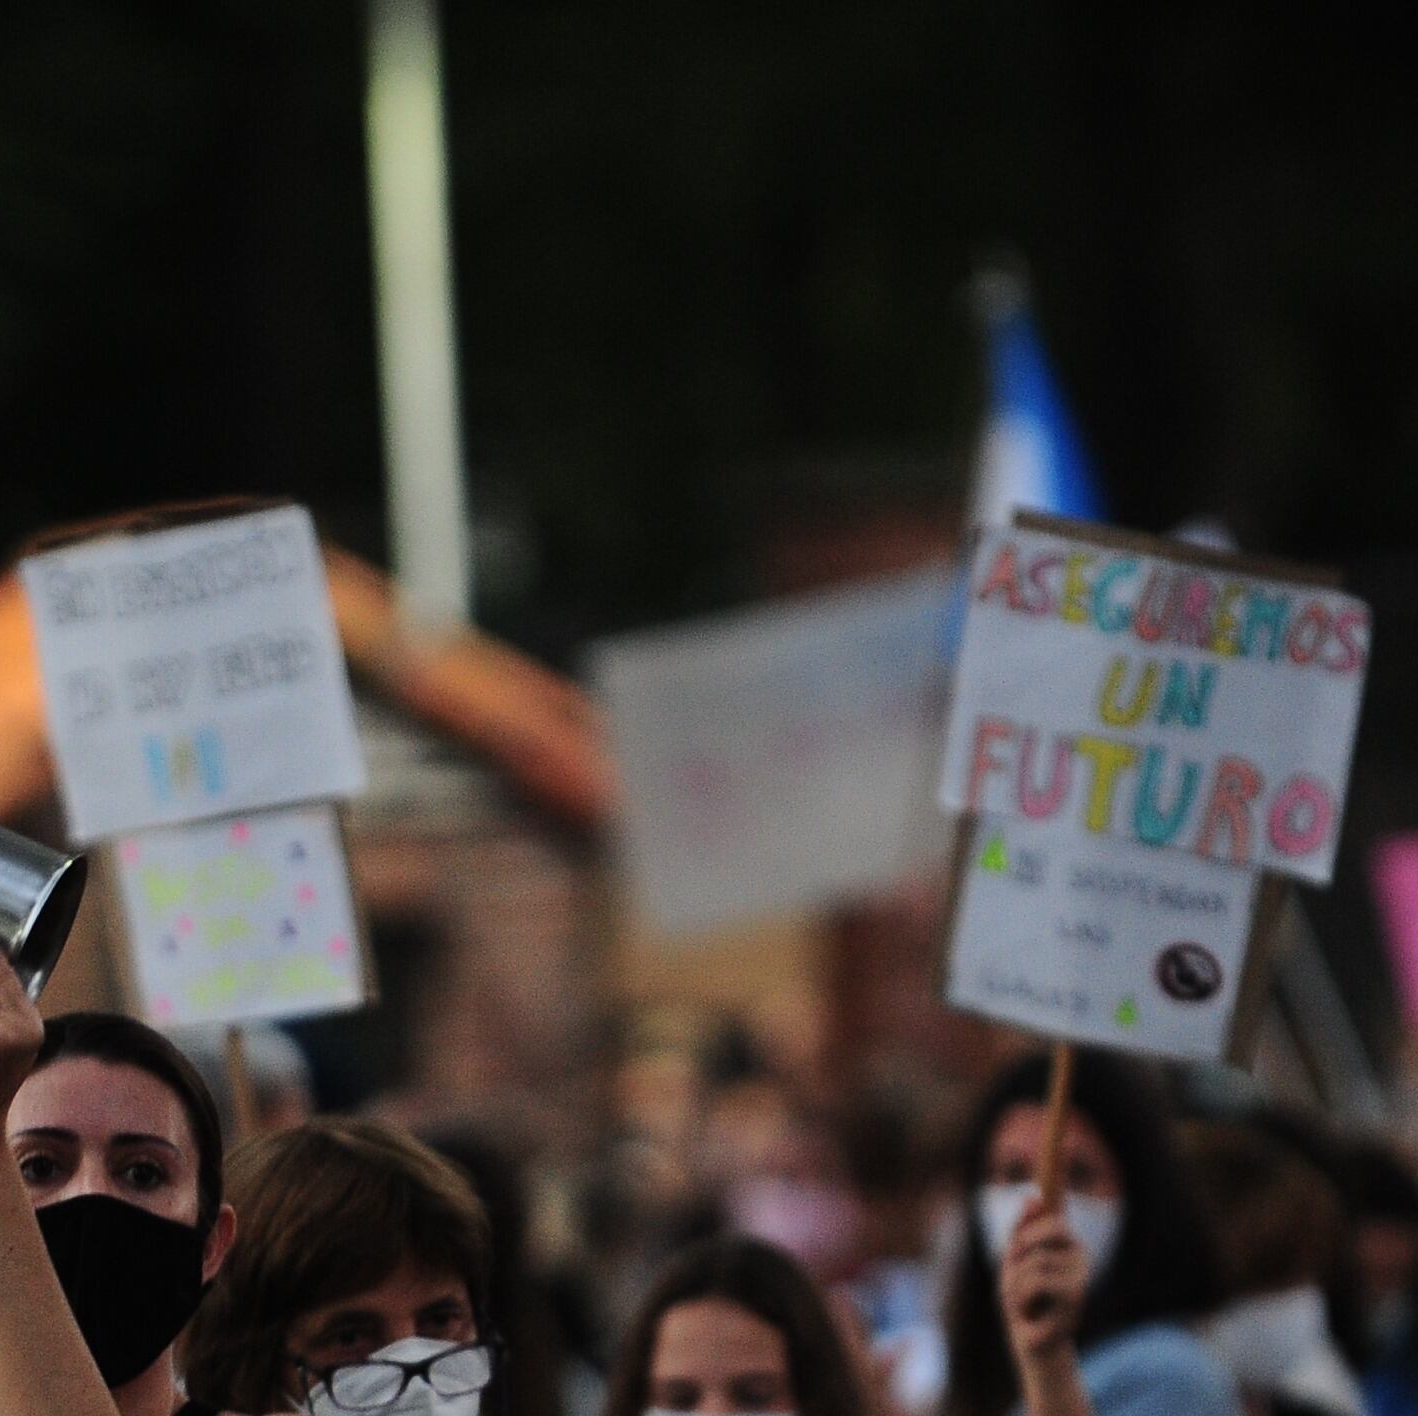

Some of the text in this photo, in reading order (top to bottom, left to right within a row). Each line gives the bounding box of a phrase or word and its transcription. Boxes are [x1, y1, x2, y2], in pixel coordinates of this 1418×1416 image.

[980, 544, 1369, 672] ASEGUREMOS
[1100, 658, 1218, 727] UN
[969, 717, 1332, 866] FUTURO
